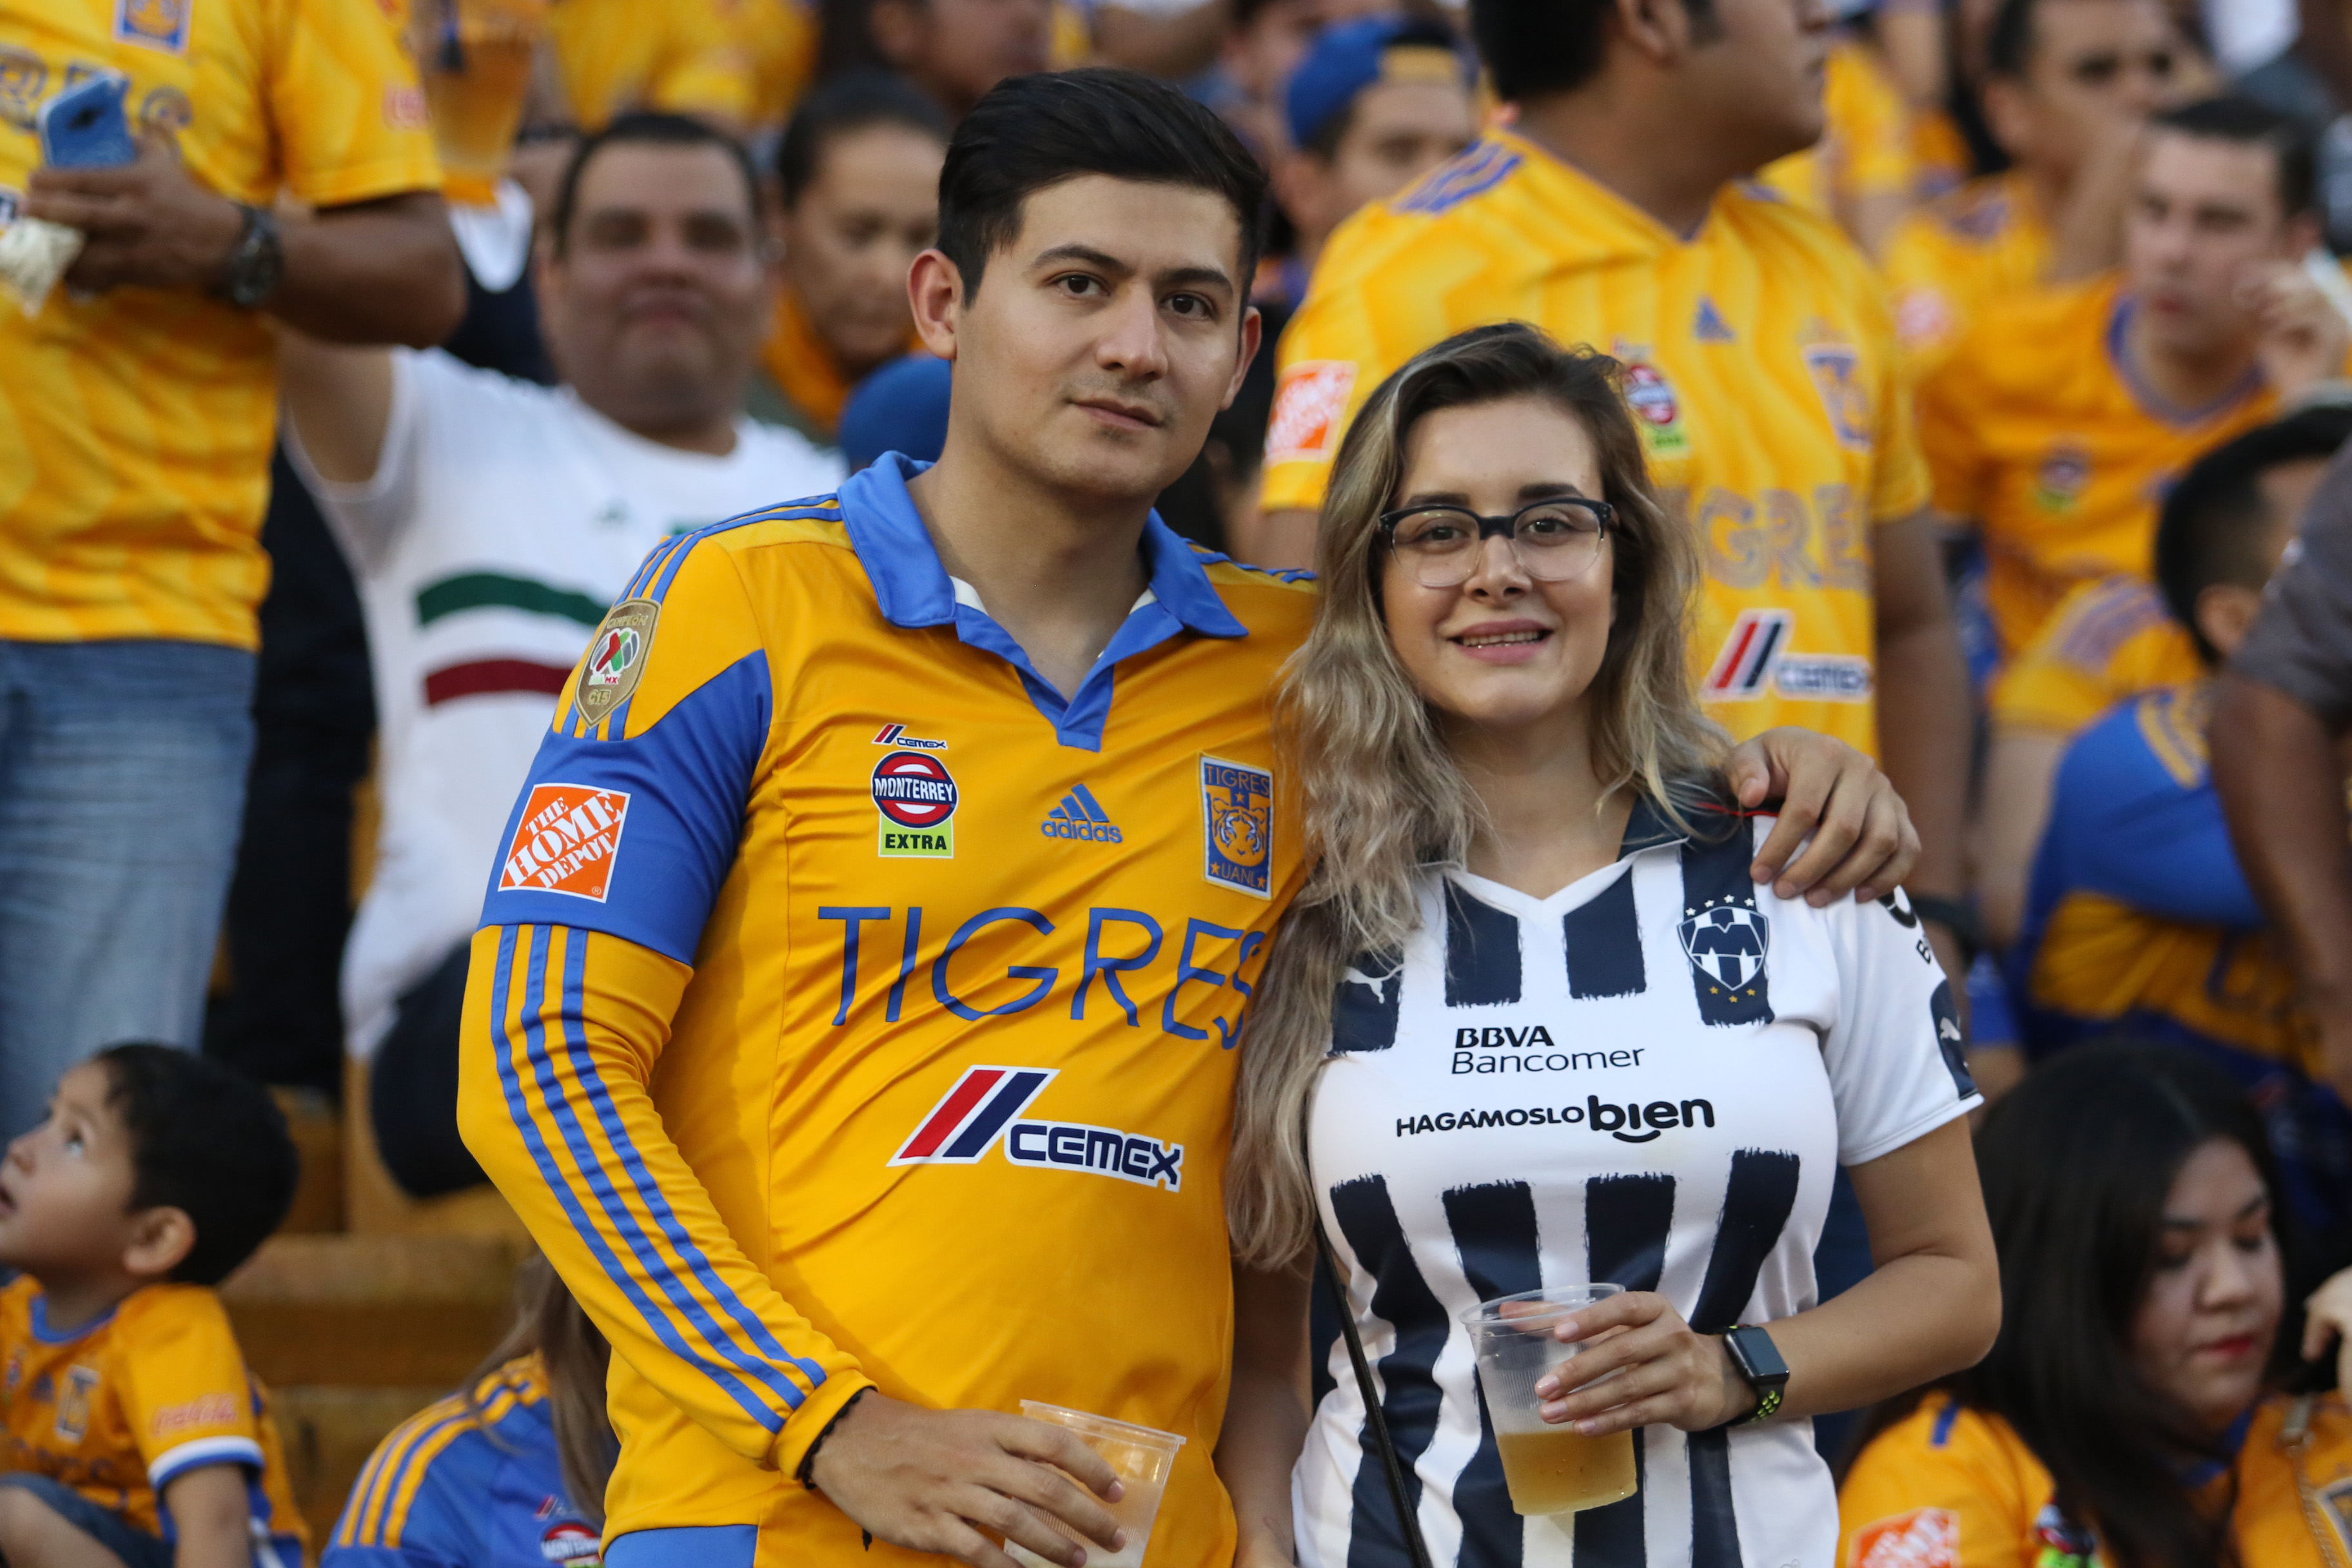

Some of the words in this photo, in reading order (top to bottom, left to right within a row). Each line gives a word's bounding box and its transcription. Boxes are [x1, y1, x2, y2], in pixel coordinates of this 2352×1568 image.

[897, 738, 946, 749] CEMEX
[874, 778, 954, 801] MONTERREY
[1205, 765, 1269, 796] TIGRES
[525, 796, 569, 836] THE
[1041, 818, 1123, 843] adidas
[506, 791, 623, 887] HOME
[885, 834, 947, 850] EXTRA
[536, 832, 614, 888] DEPOT
[1221, 863, 1256, 888] UANL
[818, 905, 1266, 1050] TIGRES
[1455, 1025, 1554, 1048] BBVA
[1451, 1048, 1645, 1075] Bancomer
[1587, 1094, 1715, 1132] bien
[1010, 1123, 1181, 1186] CEMEX
